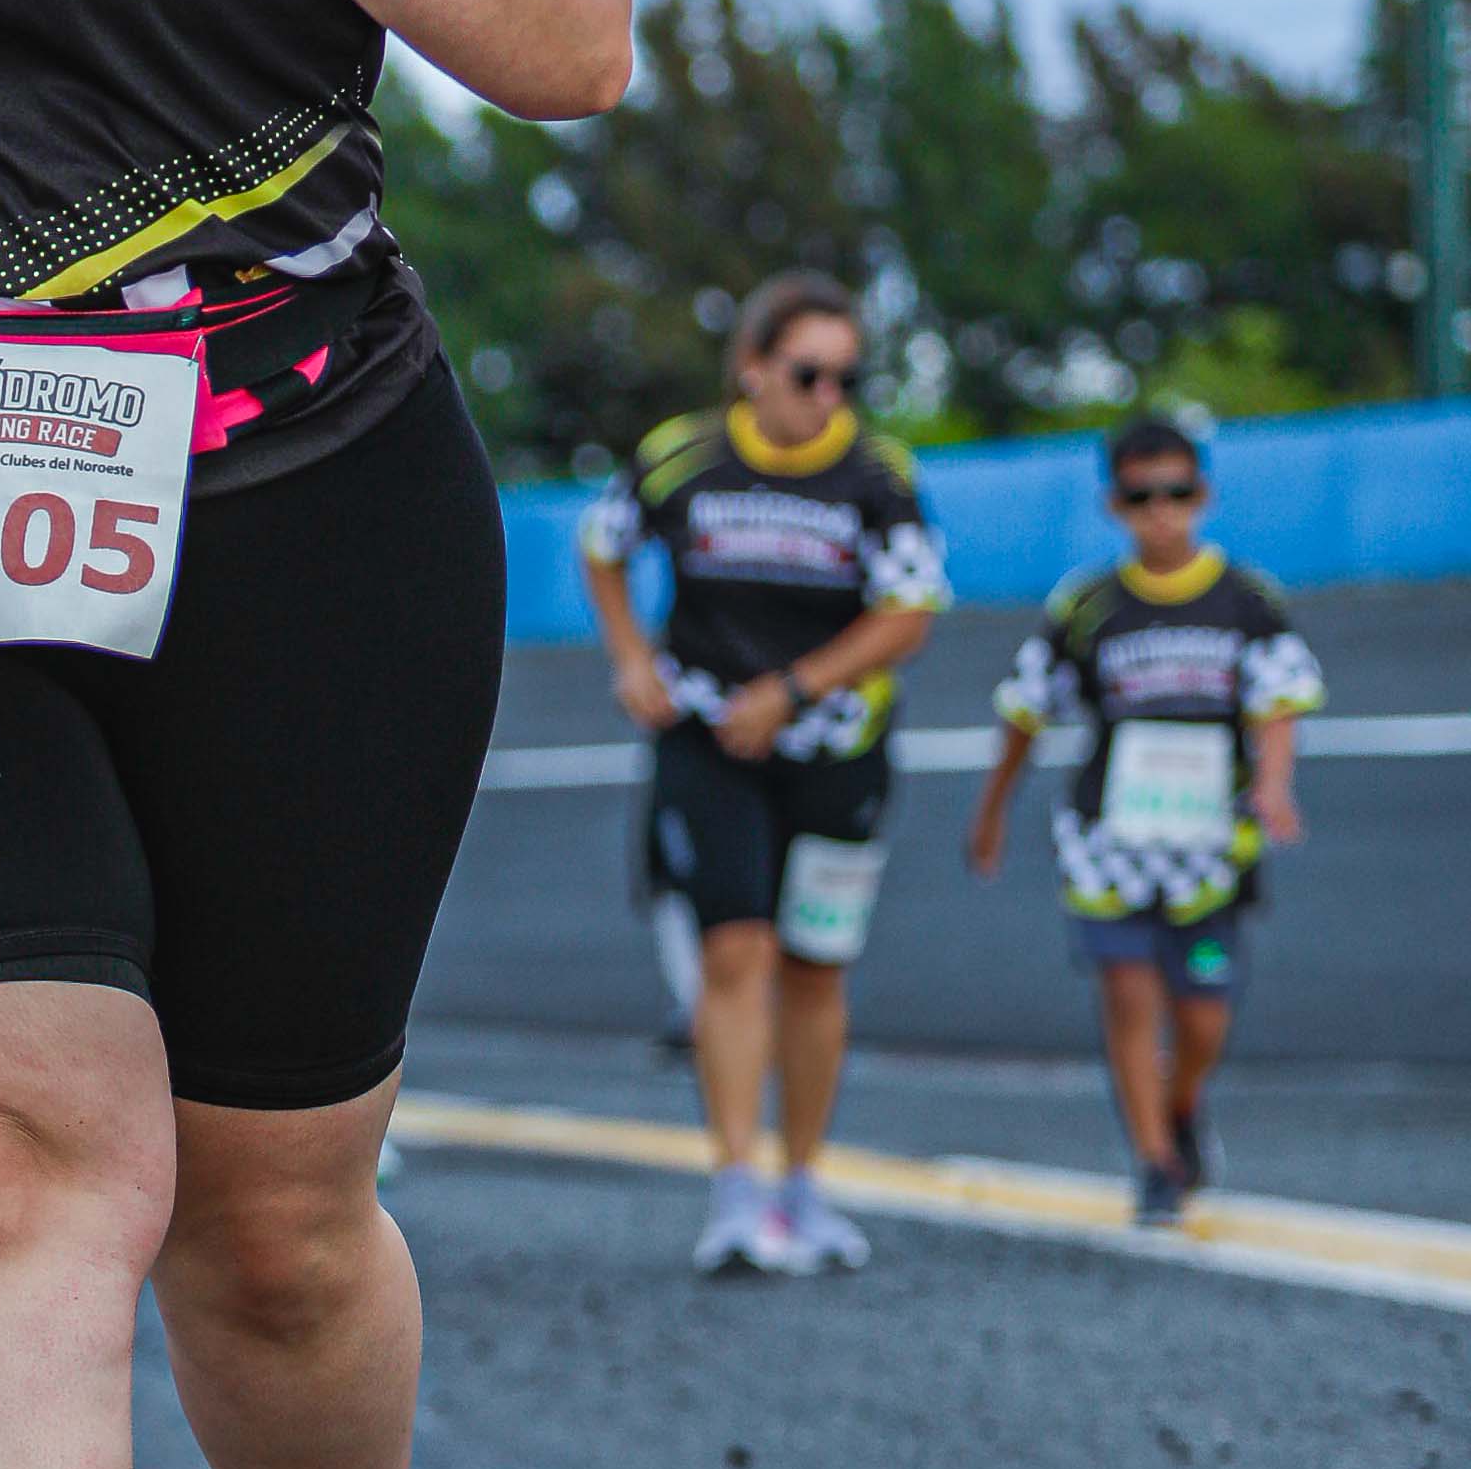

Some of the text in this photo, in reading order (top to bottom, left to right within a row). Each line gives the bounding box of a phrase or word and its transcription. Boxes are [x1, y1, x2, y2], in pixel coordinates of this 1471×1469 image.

[37, 419, 97, 450] RACE
[0, 453, 46, 469] Clubes
[49, 457, 71, 471] del
[73, 458, 134, 477] Noroeste
